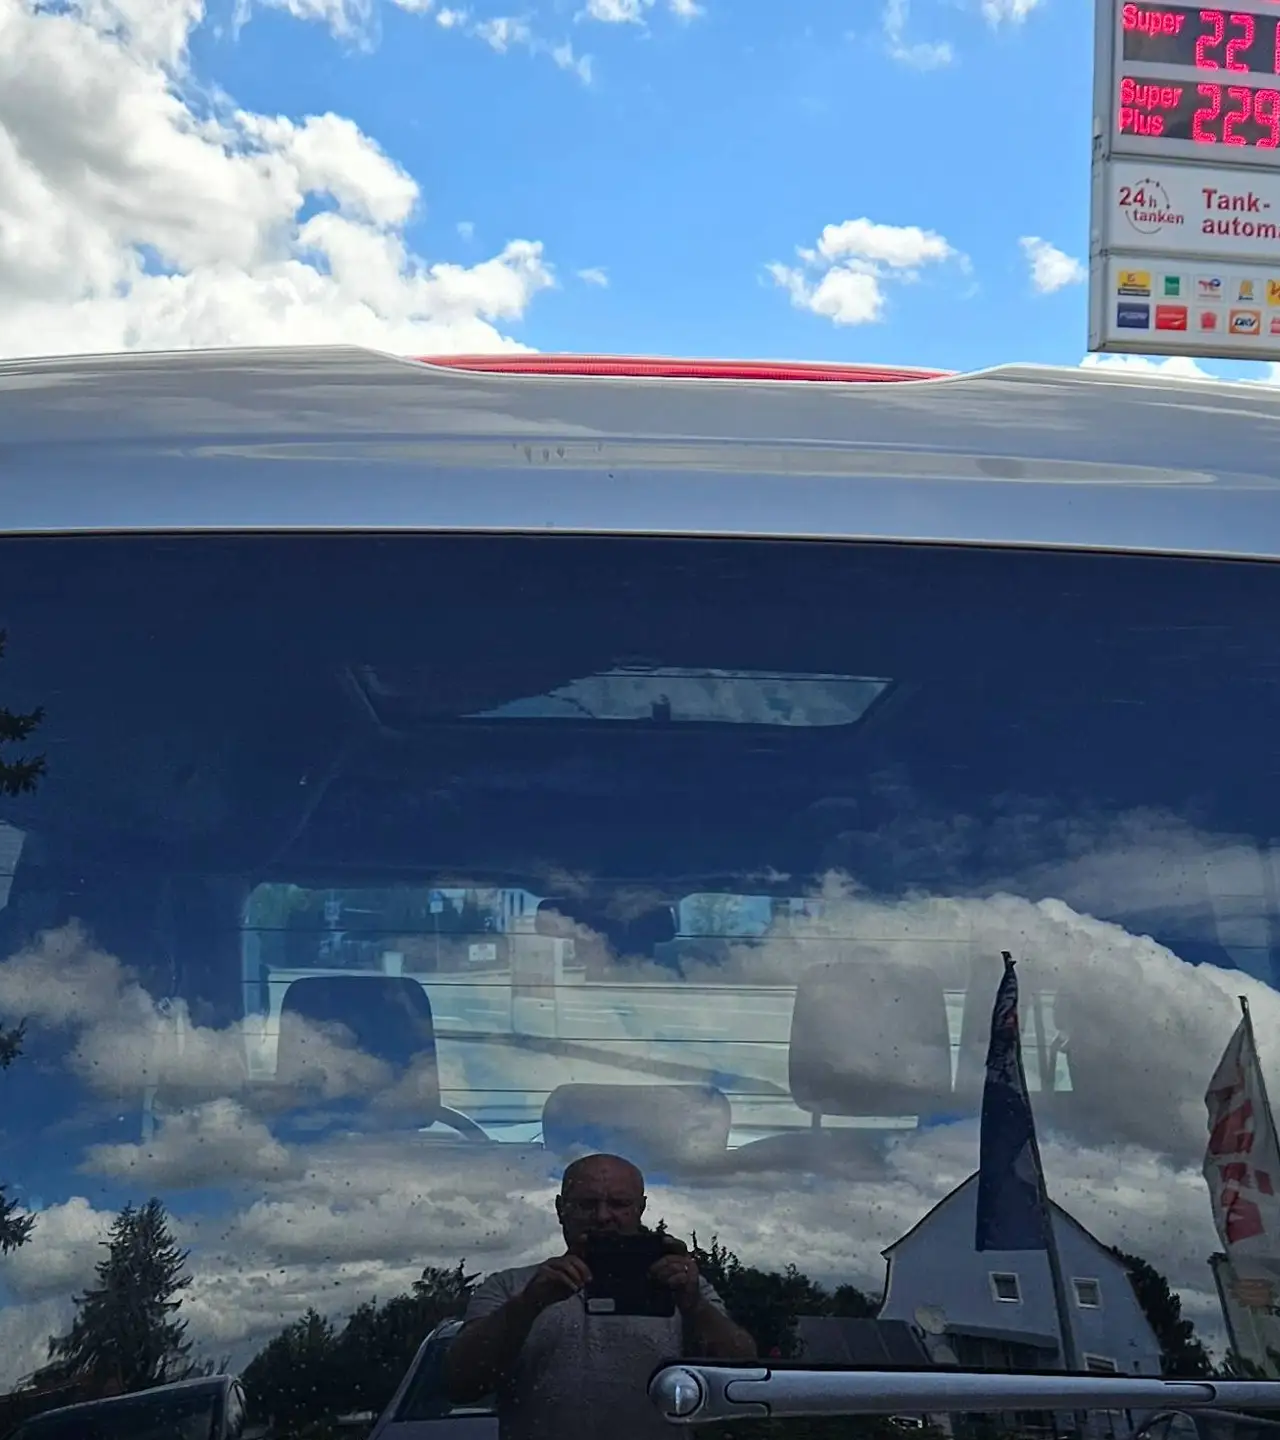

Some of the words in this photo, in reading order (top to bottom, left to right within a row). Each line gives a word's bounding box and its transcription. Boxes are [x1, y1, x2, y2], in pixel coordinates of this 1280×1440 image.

[1122, 3, 1185, 36] Super
[1120, 78, 1182, 110] Super
[1120, 107, 1164, 136] Plus
[1202, 188, 1270, 212] Tank-
[1133, 209, 1184, 225] tanken
